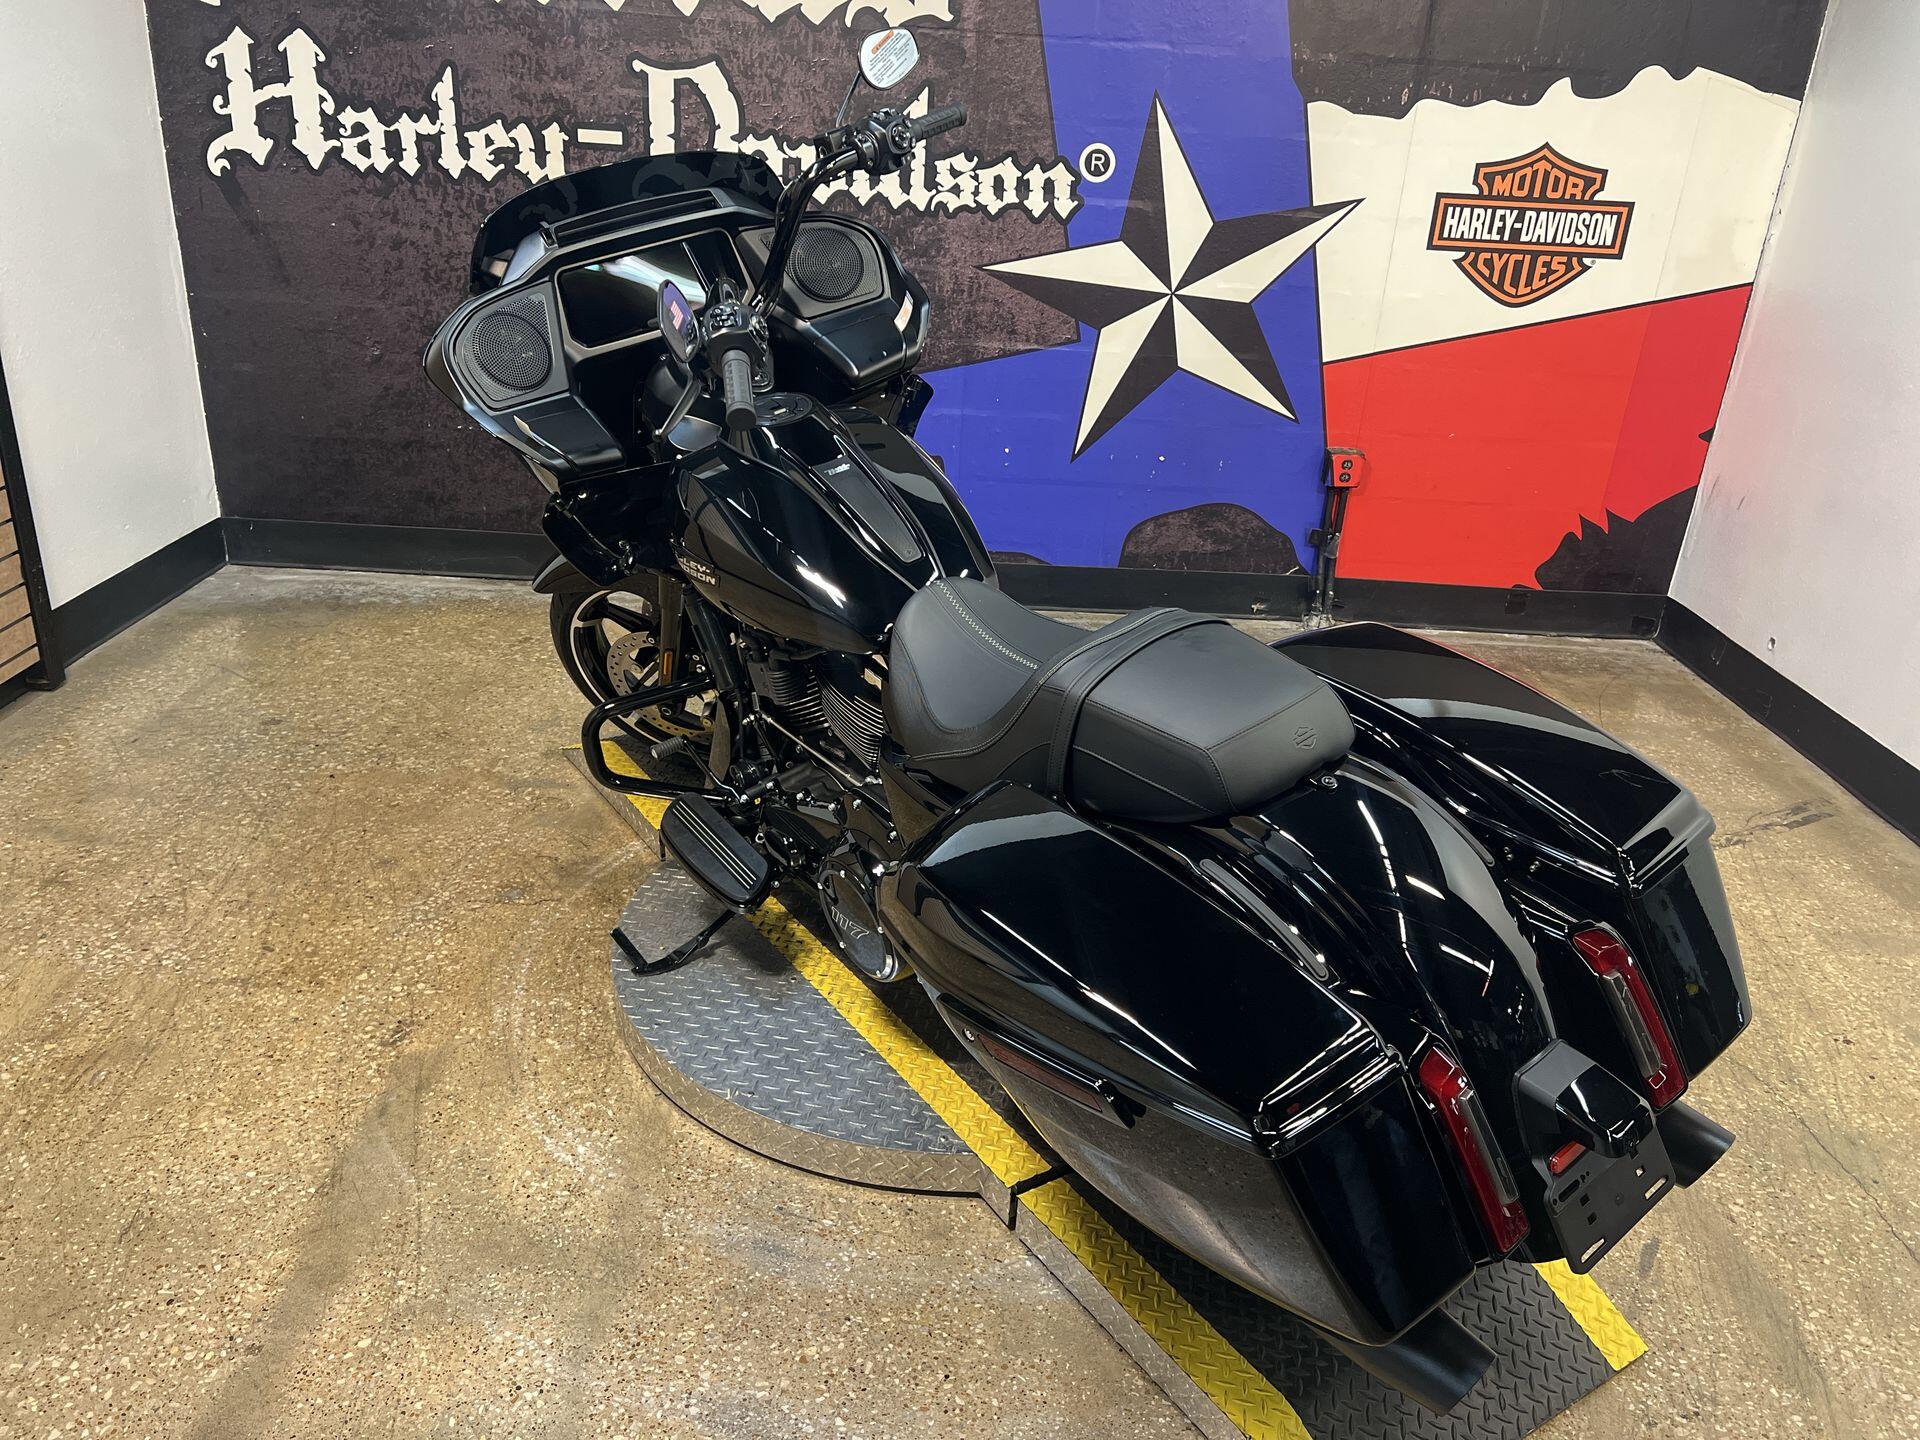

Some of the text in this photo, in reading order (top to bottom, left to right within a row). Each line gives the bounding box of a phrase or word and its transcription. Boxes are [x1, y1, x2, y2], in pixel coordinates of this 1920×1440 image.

[1492, 159, 1585, 200] MOTOR
[1443, 206, 1617, 246] HARLEY-DAVIDSON
[1477, 252, 1568, 295] CYCLES
[831, 906, 870, 939] 117
